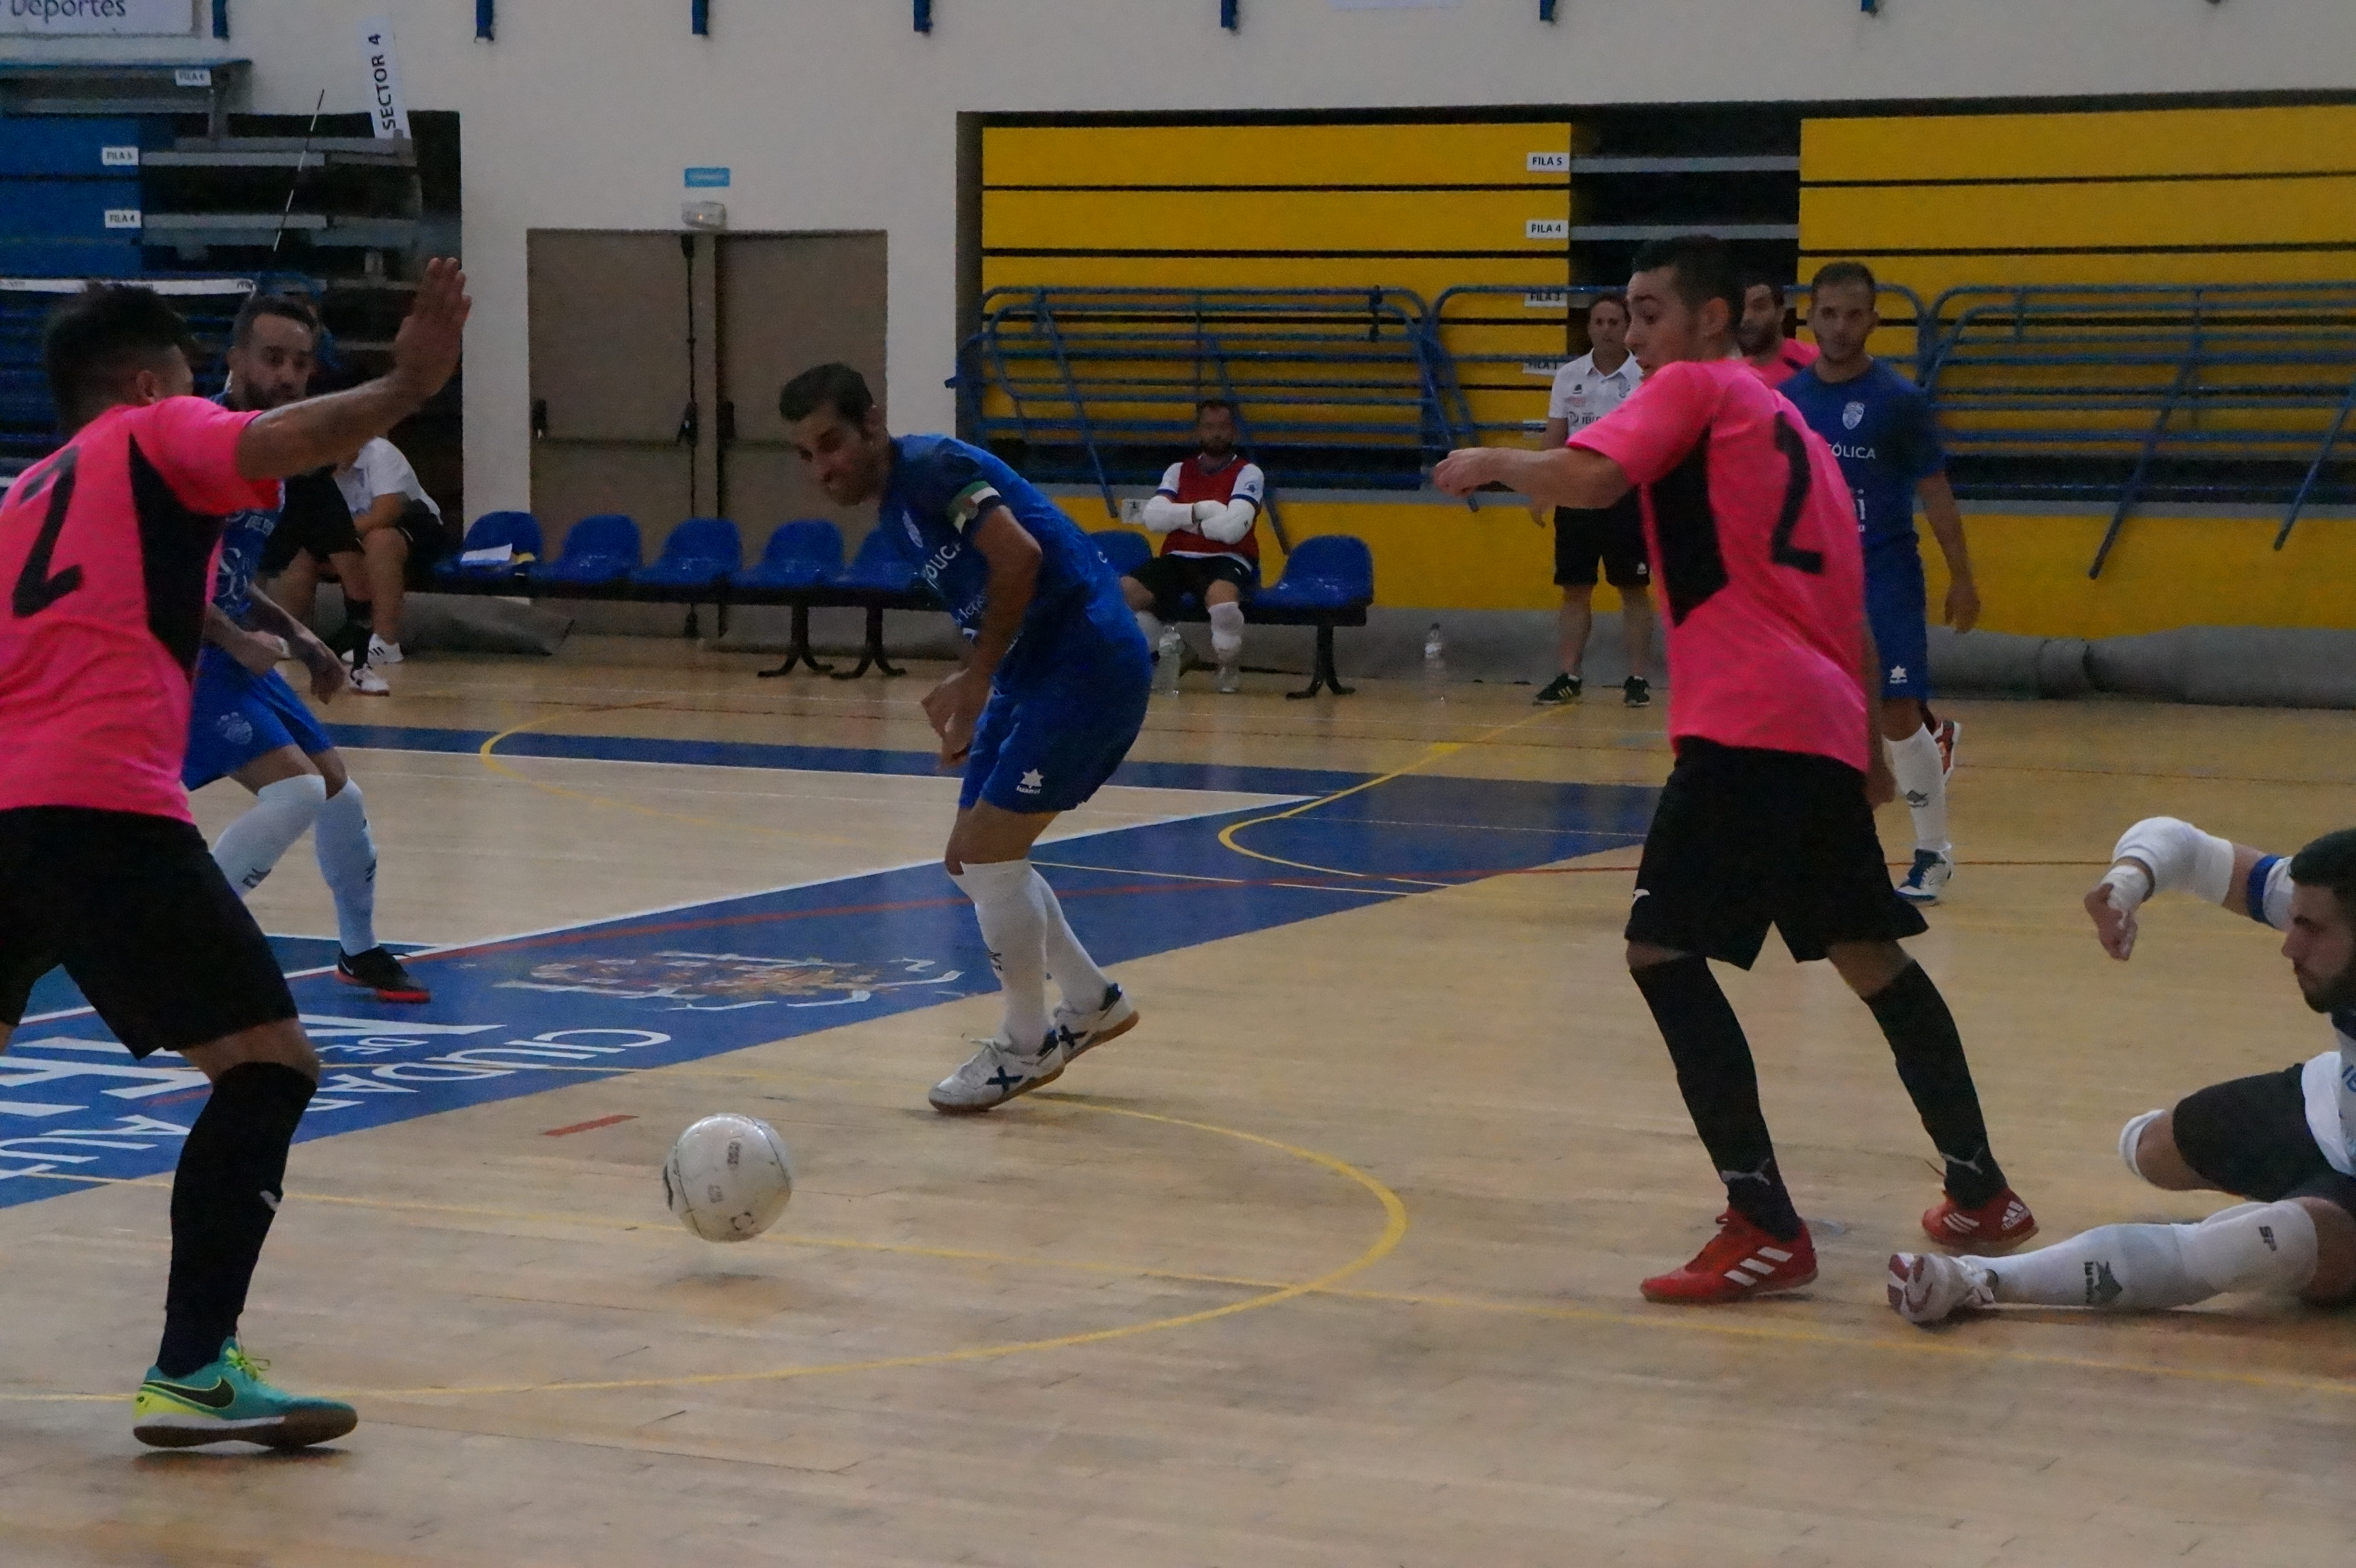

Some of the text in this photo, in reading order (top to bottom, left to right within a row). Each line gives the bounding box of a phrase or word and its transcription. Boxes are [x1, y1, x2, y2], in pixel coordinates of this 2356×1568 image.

[368, 33, 396, 130] SECTOR 4
[1533, 156, 1562, 165] FILA 5
[1531, 224, 1561, 233] FILA 4
[1828, 441, 1876, 459] ÓLICA
[1771, 411, 1824, 575] 2
[12, 445, 83, 618] 2
